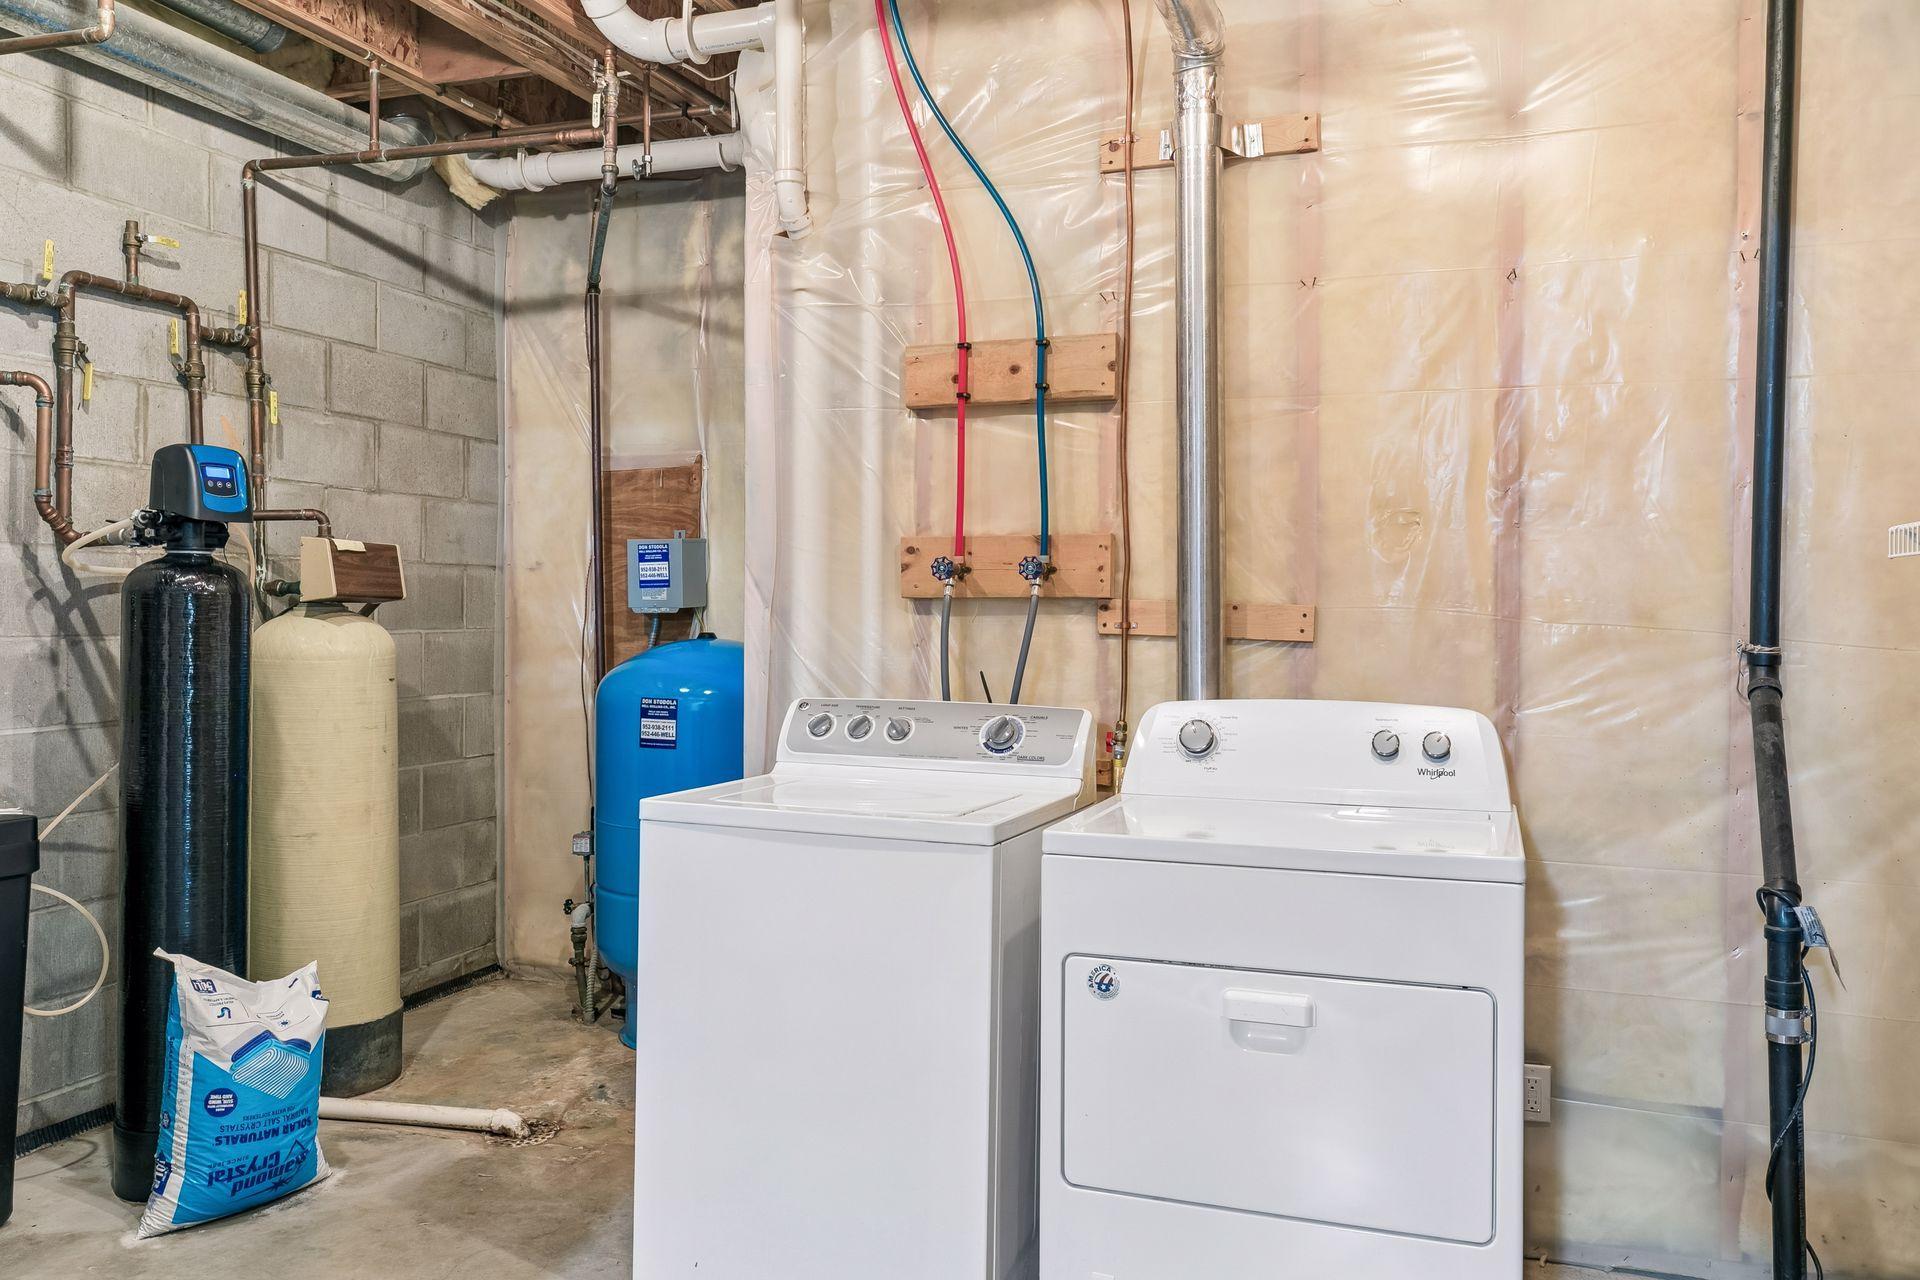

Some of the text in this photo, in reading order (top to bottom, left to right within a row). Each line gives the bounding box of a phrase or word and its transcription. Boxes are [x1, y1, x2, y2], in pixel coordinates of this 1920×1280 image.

[1417, 768, 1455, 778] Whirlpool
[1088, 965, 1111, 988] AMERICA
[215, 1116, 312, 1146] SOLAR NATURALS
[220, 1107, 308, 1133] NATURAL SALT CRYSTALS
[208, 1150, 280, 1187] Crystal
